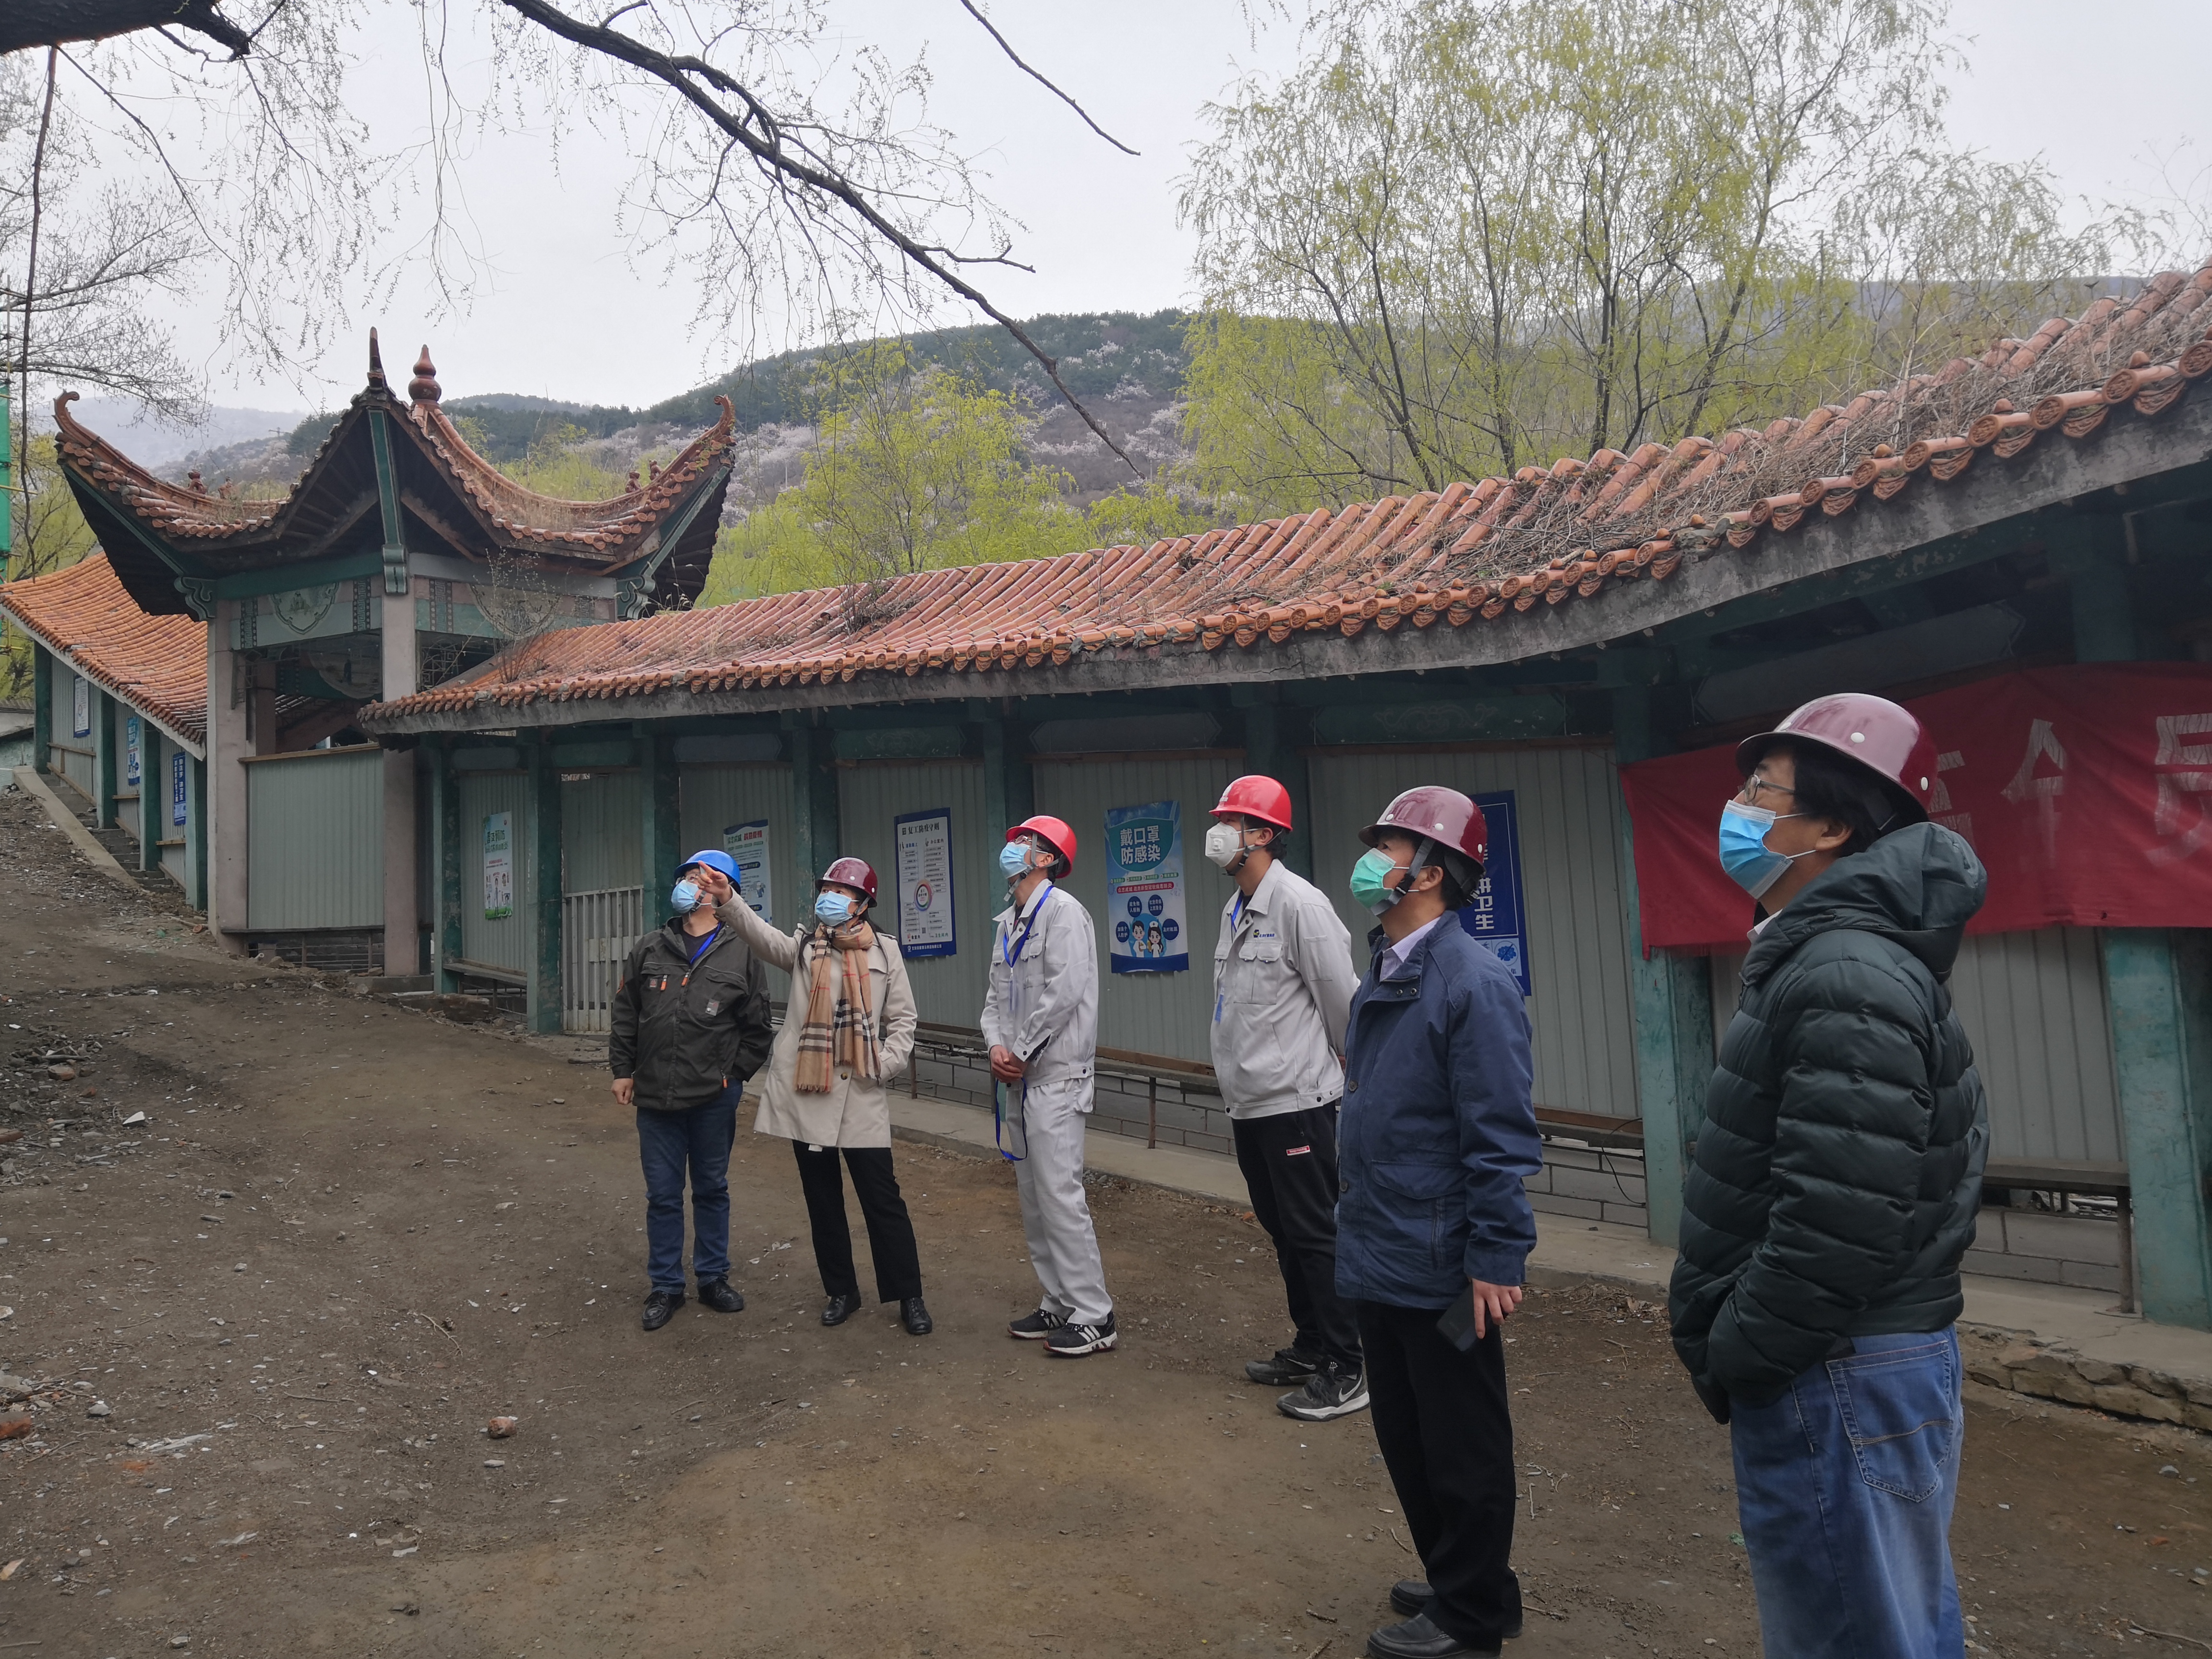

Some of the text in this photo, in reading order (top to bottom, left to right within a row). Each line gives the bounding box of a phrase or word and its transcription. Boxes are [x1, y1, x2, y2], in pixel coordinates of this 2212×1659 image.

[908, 822, 939, 835] 复工防疫守则
[1120, 825, 1160, 847] 戴口罩
[1120, 844, 1161, 865] 防感染
